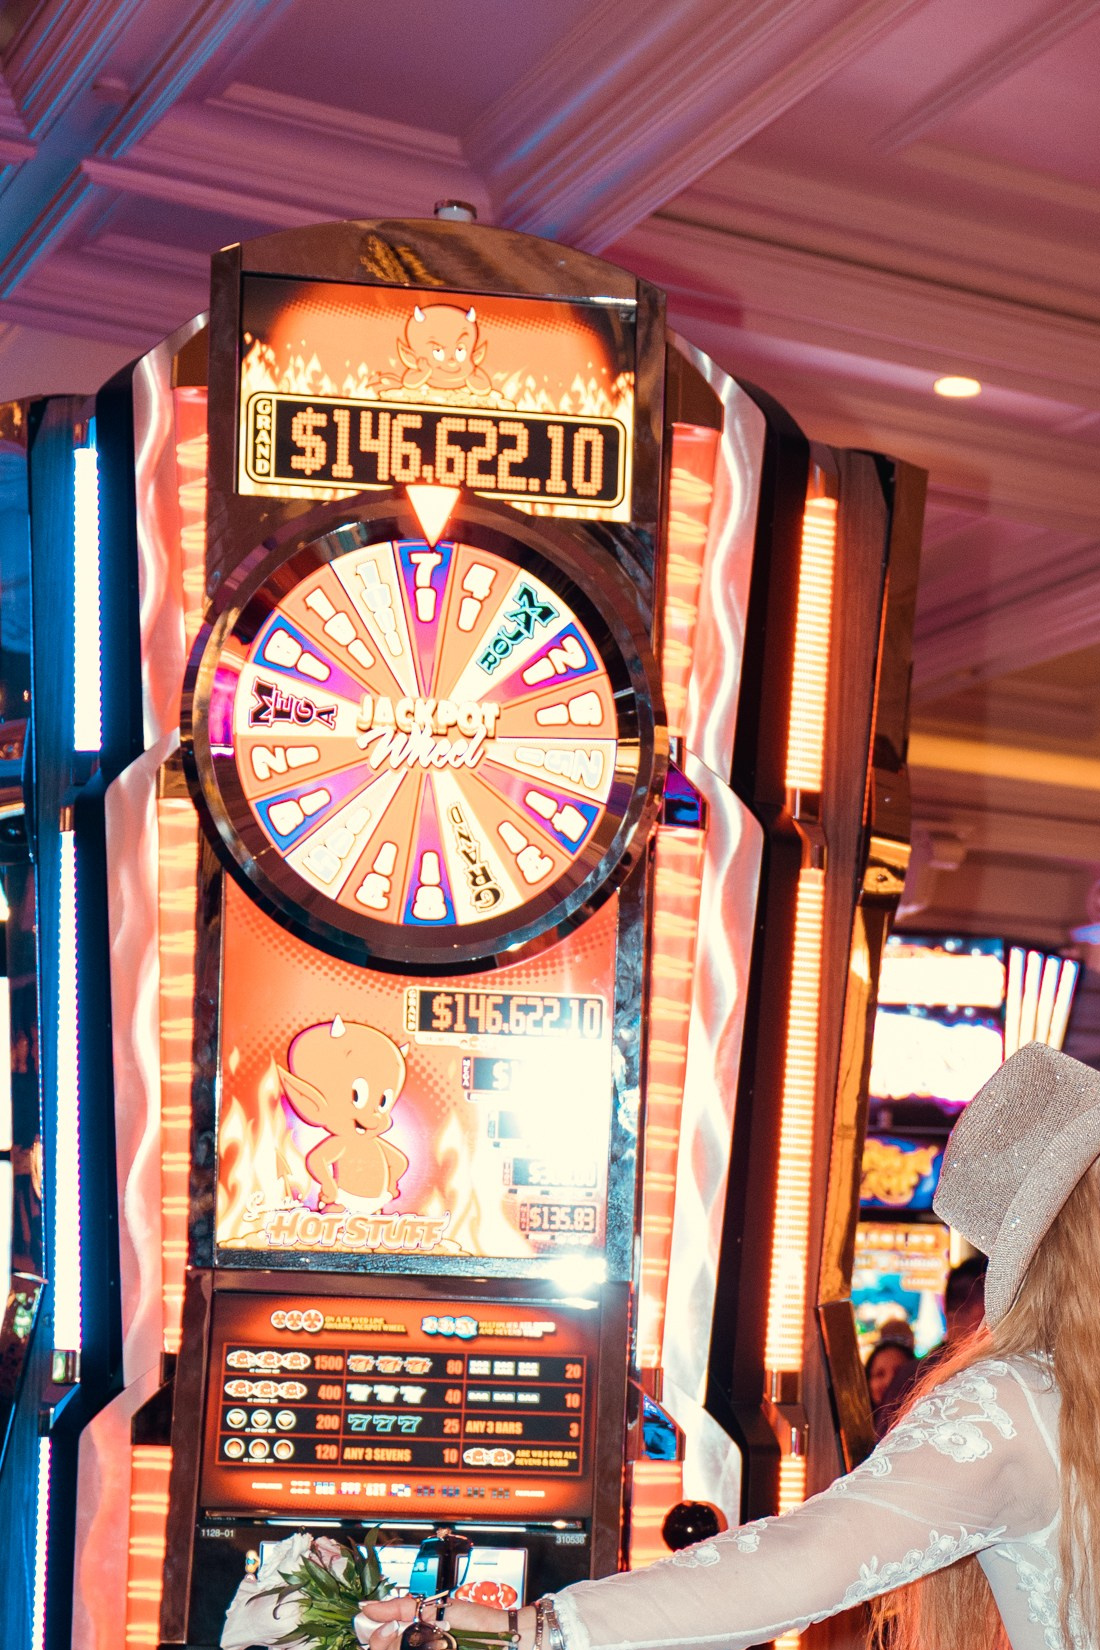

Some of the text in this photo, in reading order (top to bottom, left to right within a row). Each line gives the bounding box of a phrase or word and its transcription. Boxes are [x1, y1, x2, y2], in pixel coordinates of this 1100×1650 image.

[253, 399, 272, 475] GRAND
[291, 406, 604, 496] $146,622.10
[476, 582, 560, 675] MAJOR
[249, 677, 338, 728] MEGA
[356, 694, 500, 739] JACKPOT
[356, 722, 486, 769] Wheel
[449, 804, 502, 910] GRAND
[268, 1212, 446, 1250] HOT STUFF
[314, 1355, 344, 1371] 1500
[446, 1359, 463, 1375] 80
[565, 1363, 581, 1379] 20
[317, 1384, 342, 1400] 400
[444, 1388, 462, 1405] 40
[565, 1393, 580, 1409] 10
[315, 1414, 340, 1430] 200
[443, 1418, 460, 1434] 25
[465, 1420, 523, 1435] ANY 3 BARS
[569, 1422, 579, 1438] 3
[314, 1444, 339, 1460] 120
[343, 1447, 412, 1462] ANY 3 SEVENS
[442, 1448, 458, 1464] 10
[201, 1529, 235, 1538] 1128-01
